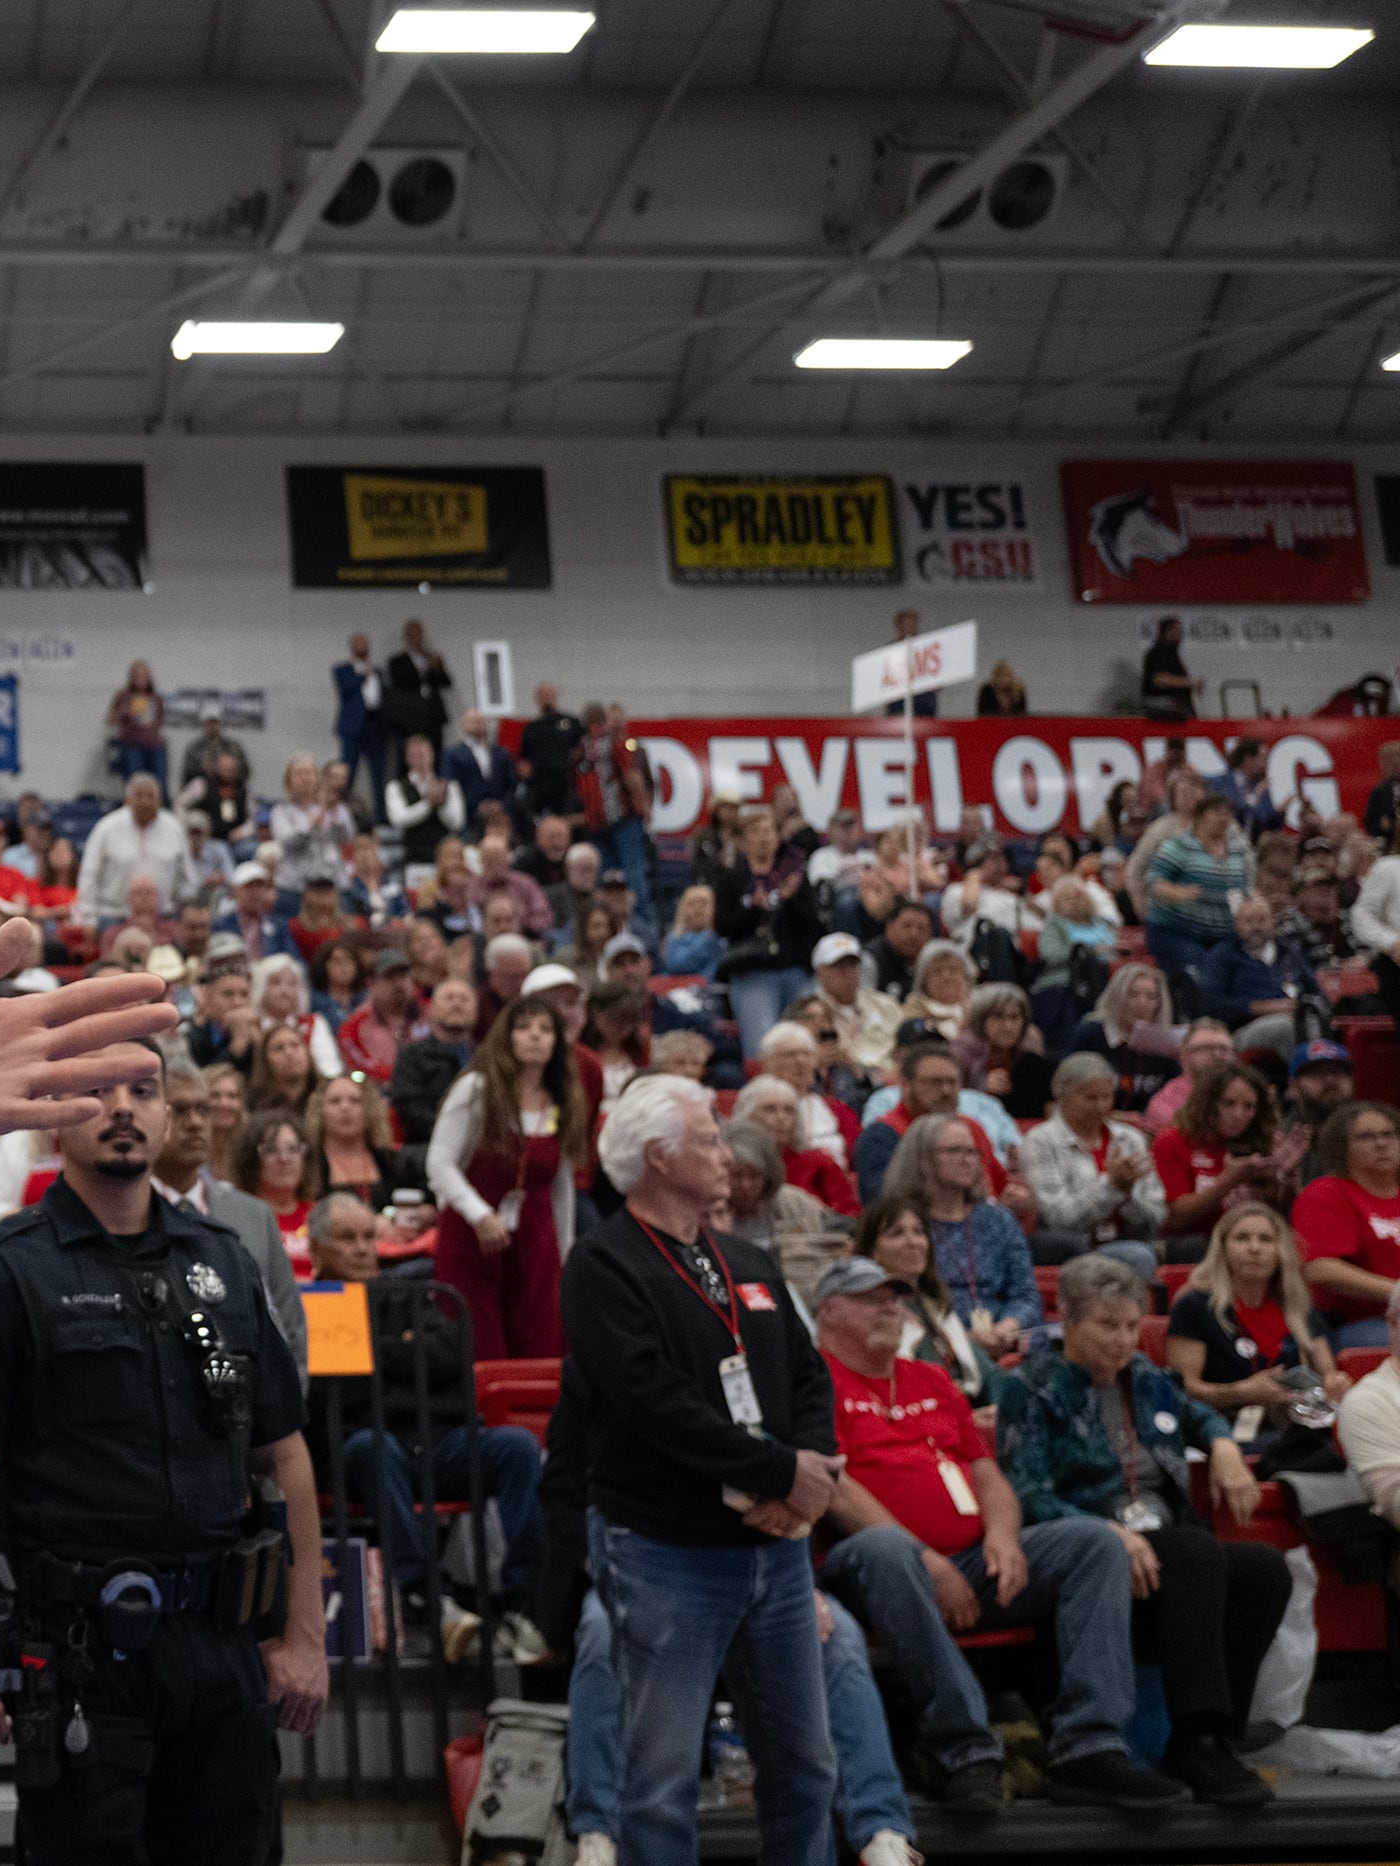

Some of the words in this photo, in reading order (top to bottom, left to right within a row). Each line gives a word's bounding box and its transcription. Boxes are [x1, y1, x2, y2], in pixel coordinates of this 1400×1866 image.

[684, 491, 882, 547] SPRADLEY
[905, 483, 1027, 529] YES!
[951, 538, 1033, 578] CSU
[643, 735, 1341, 834] DEVELOPG
